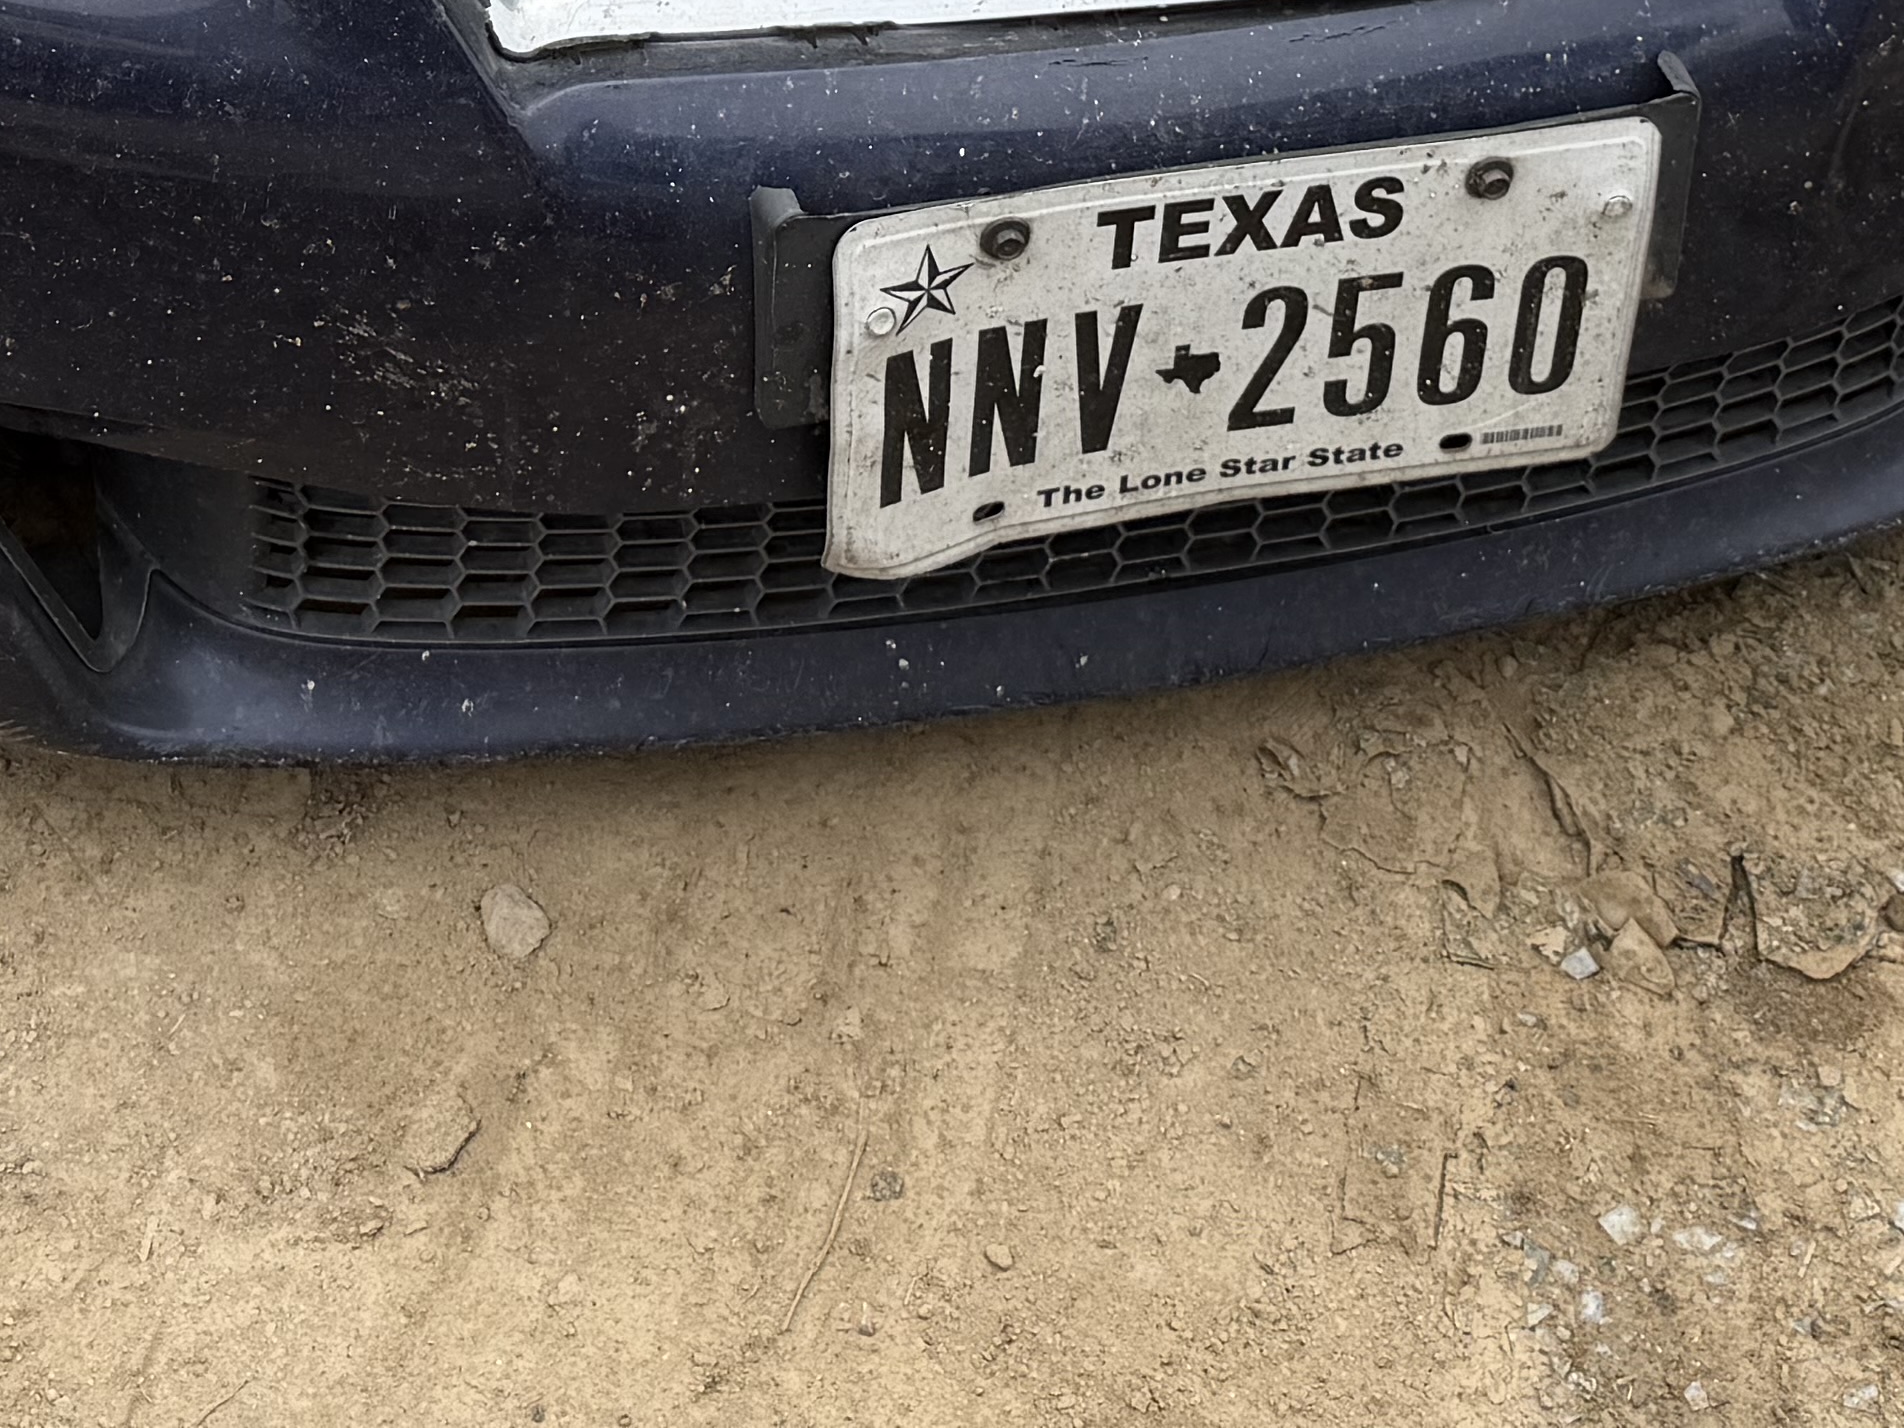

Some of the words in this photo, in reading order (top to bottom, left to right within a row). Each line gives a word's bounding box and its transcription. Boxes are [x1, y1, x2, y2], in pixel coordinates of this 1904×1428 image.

[1097, 177, 1404, 269] TEXAS
[880, 304, 1143, 508] NNV
[1226, 255, 1590, 433] 2560
[1037, 483, 1106, 508] The
[1118, 466, 1207, 494] Lone
[1219, 454, 1296, 479] Star
[1306, 442, 1405, 468] State
